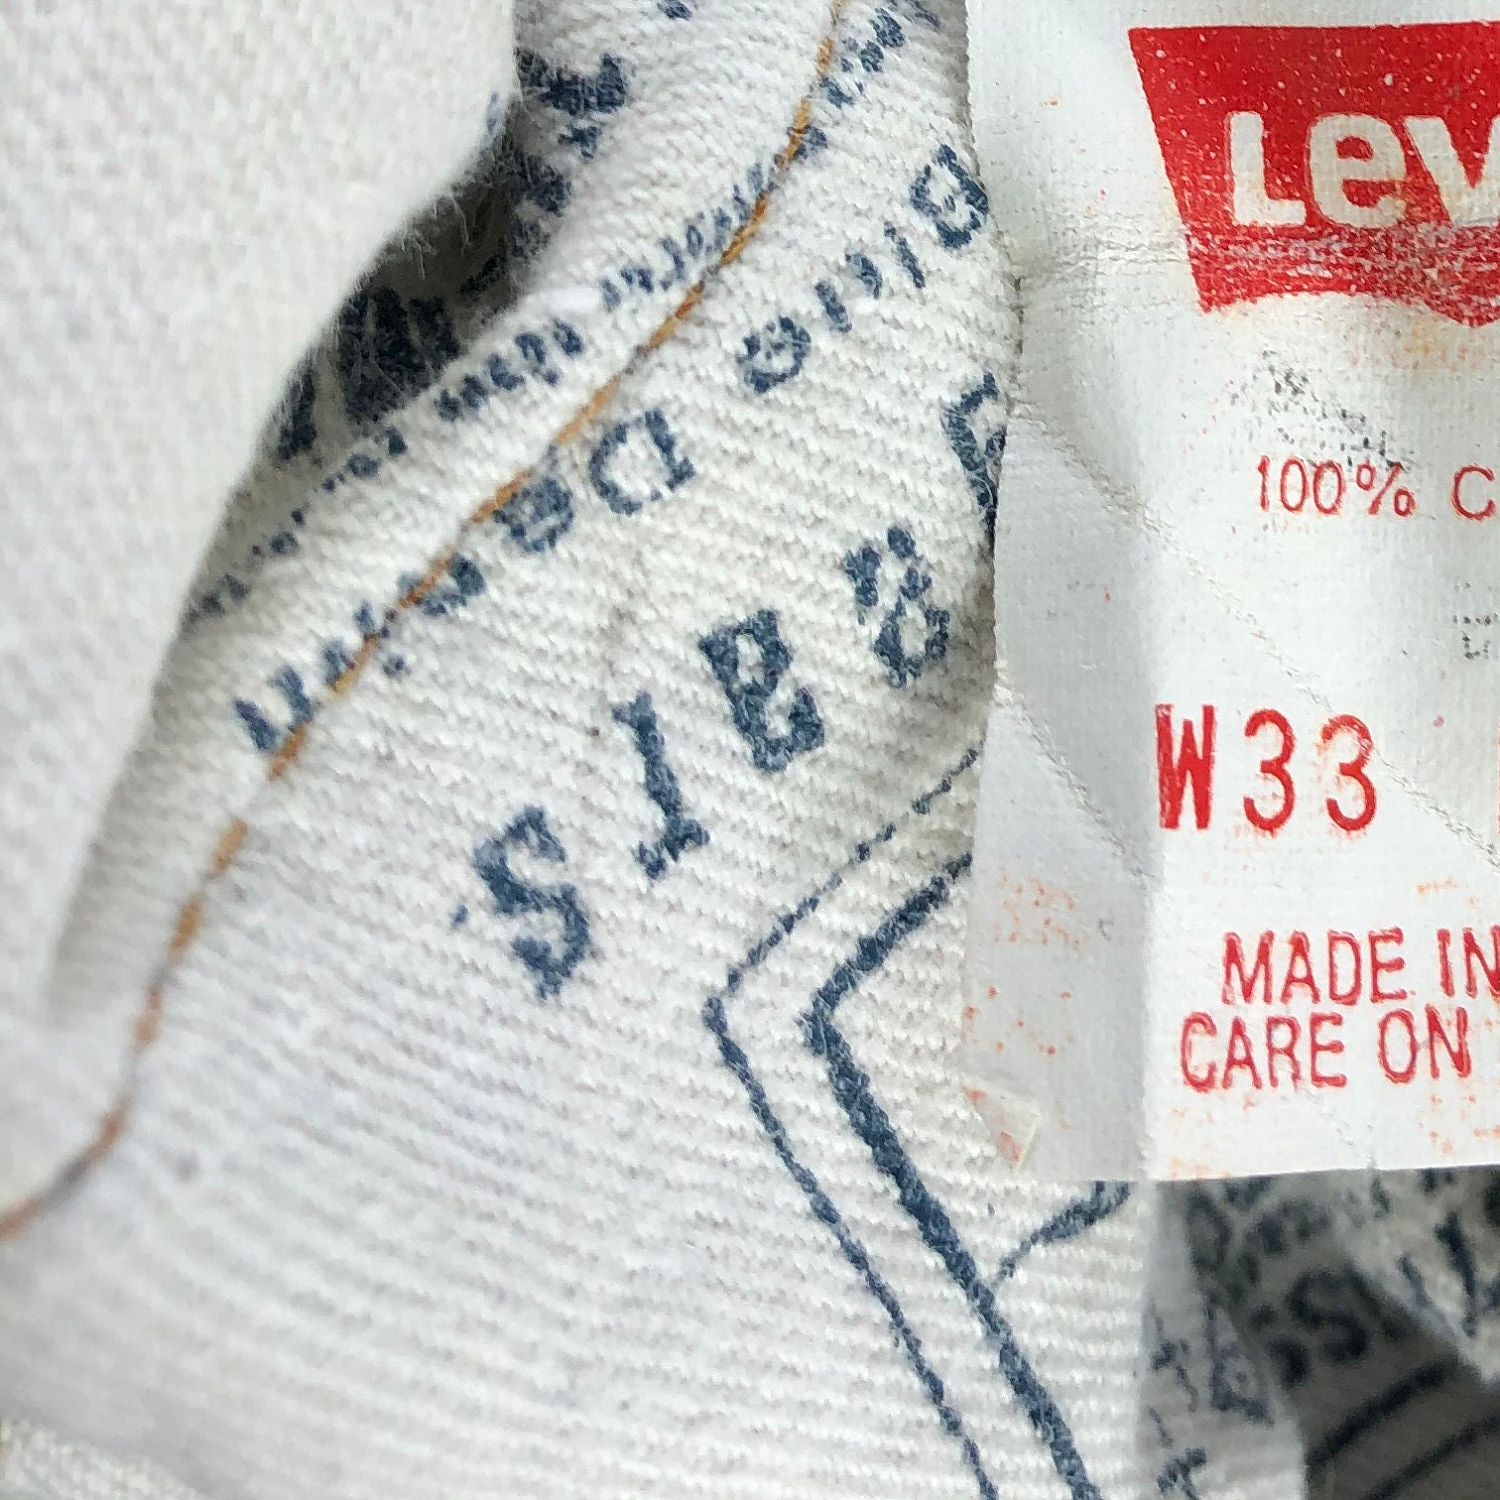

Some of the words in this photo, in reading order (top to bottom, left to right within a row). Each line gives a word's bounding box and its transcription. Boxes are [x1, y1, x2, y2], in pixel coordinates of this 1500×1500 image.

[1255, 454, 1416, 519] 100%
[1154, 703, 1377, 834] W33
[1221, 926, 1407, 1005] MADE
[1180, 1011, 1348, 1093] CARE
[1376, 1005, 1473, 1085] ON
